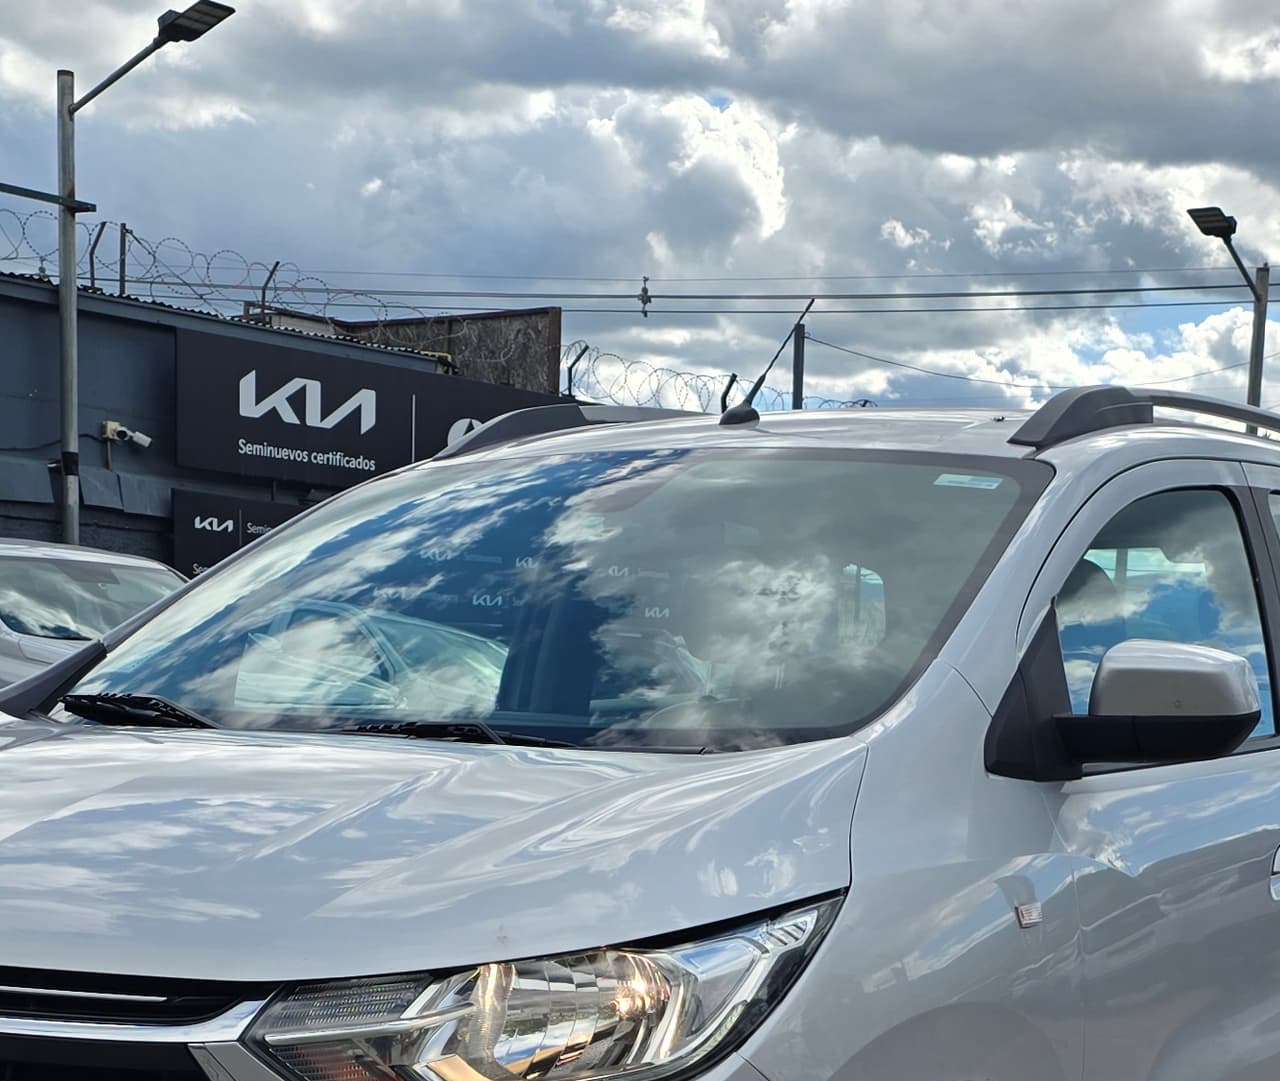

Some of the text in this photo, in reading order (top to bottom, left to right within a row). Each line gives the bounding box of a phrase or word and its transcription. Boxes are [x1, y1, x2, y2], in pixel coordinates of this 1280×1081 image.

[239, 369, 377, 435] KIA
[238, 438, 376, 471] Seminuevos certificados
[194, 515, 234, 533] KIA
